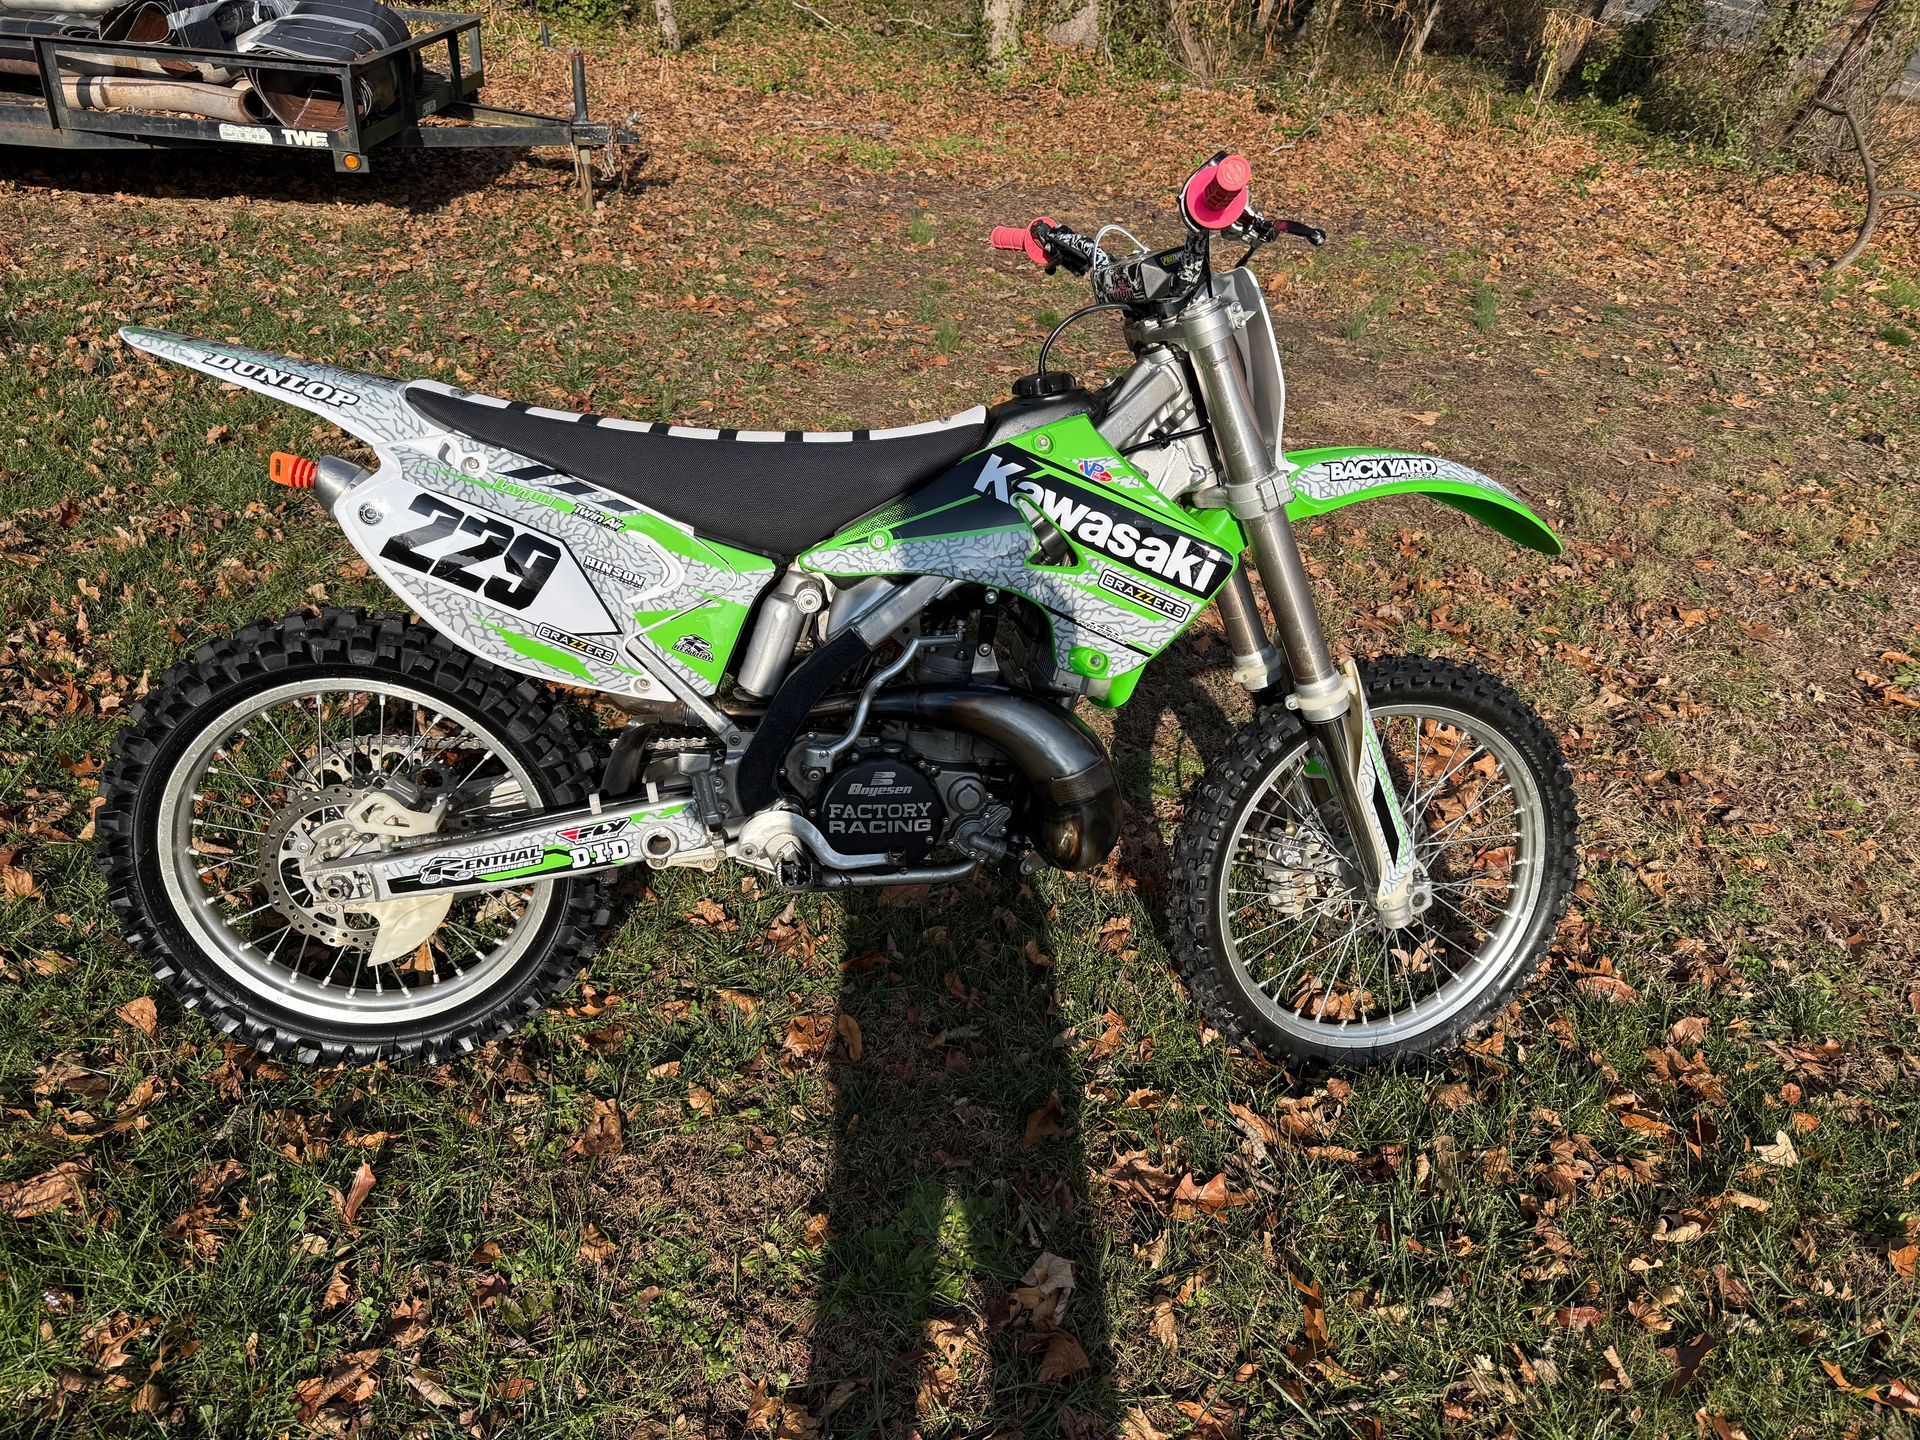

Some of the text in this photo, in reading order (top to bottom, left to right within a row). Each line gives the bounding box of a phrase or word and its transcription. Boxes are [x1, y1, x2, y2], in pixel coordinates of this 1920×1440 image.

[202, 352, 360, 408] DUNLOP
[1328, 458, 1436, 481] BACKYARD
[572, 503, 605, 524] Twin
[601, 516, 626, 531] Air
[973, 454, 1222, 592] Kawasaki
[379, 492, 561, 610] 229
[584, 556, 645, 587] HINSON
[1103, 575, 1188, 618] BRAZZERS
[539, 626, 616, 662] BRAZZERS
[848, 783, 913, 796] Boyesen
[828, 802, 932, 819] FACTORY
[562, 820, 629, 840] FLY
[828, 819, 932, 834] RACING
[420, 847, 542, 883] RENTHAL
